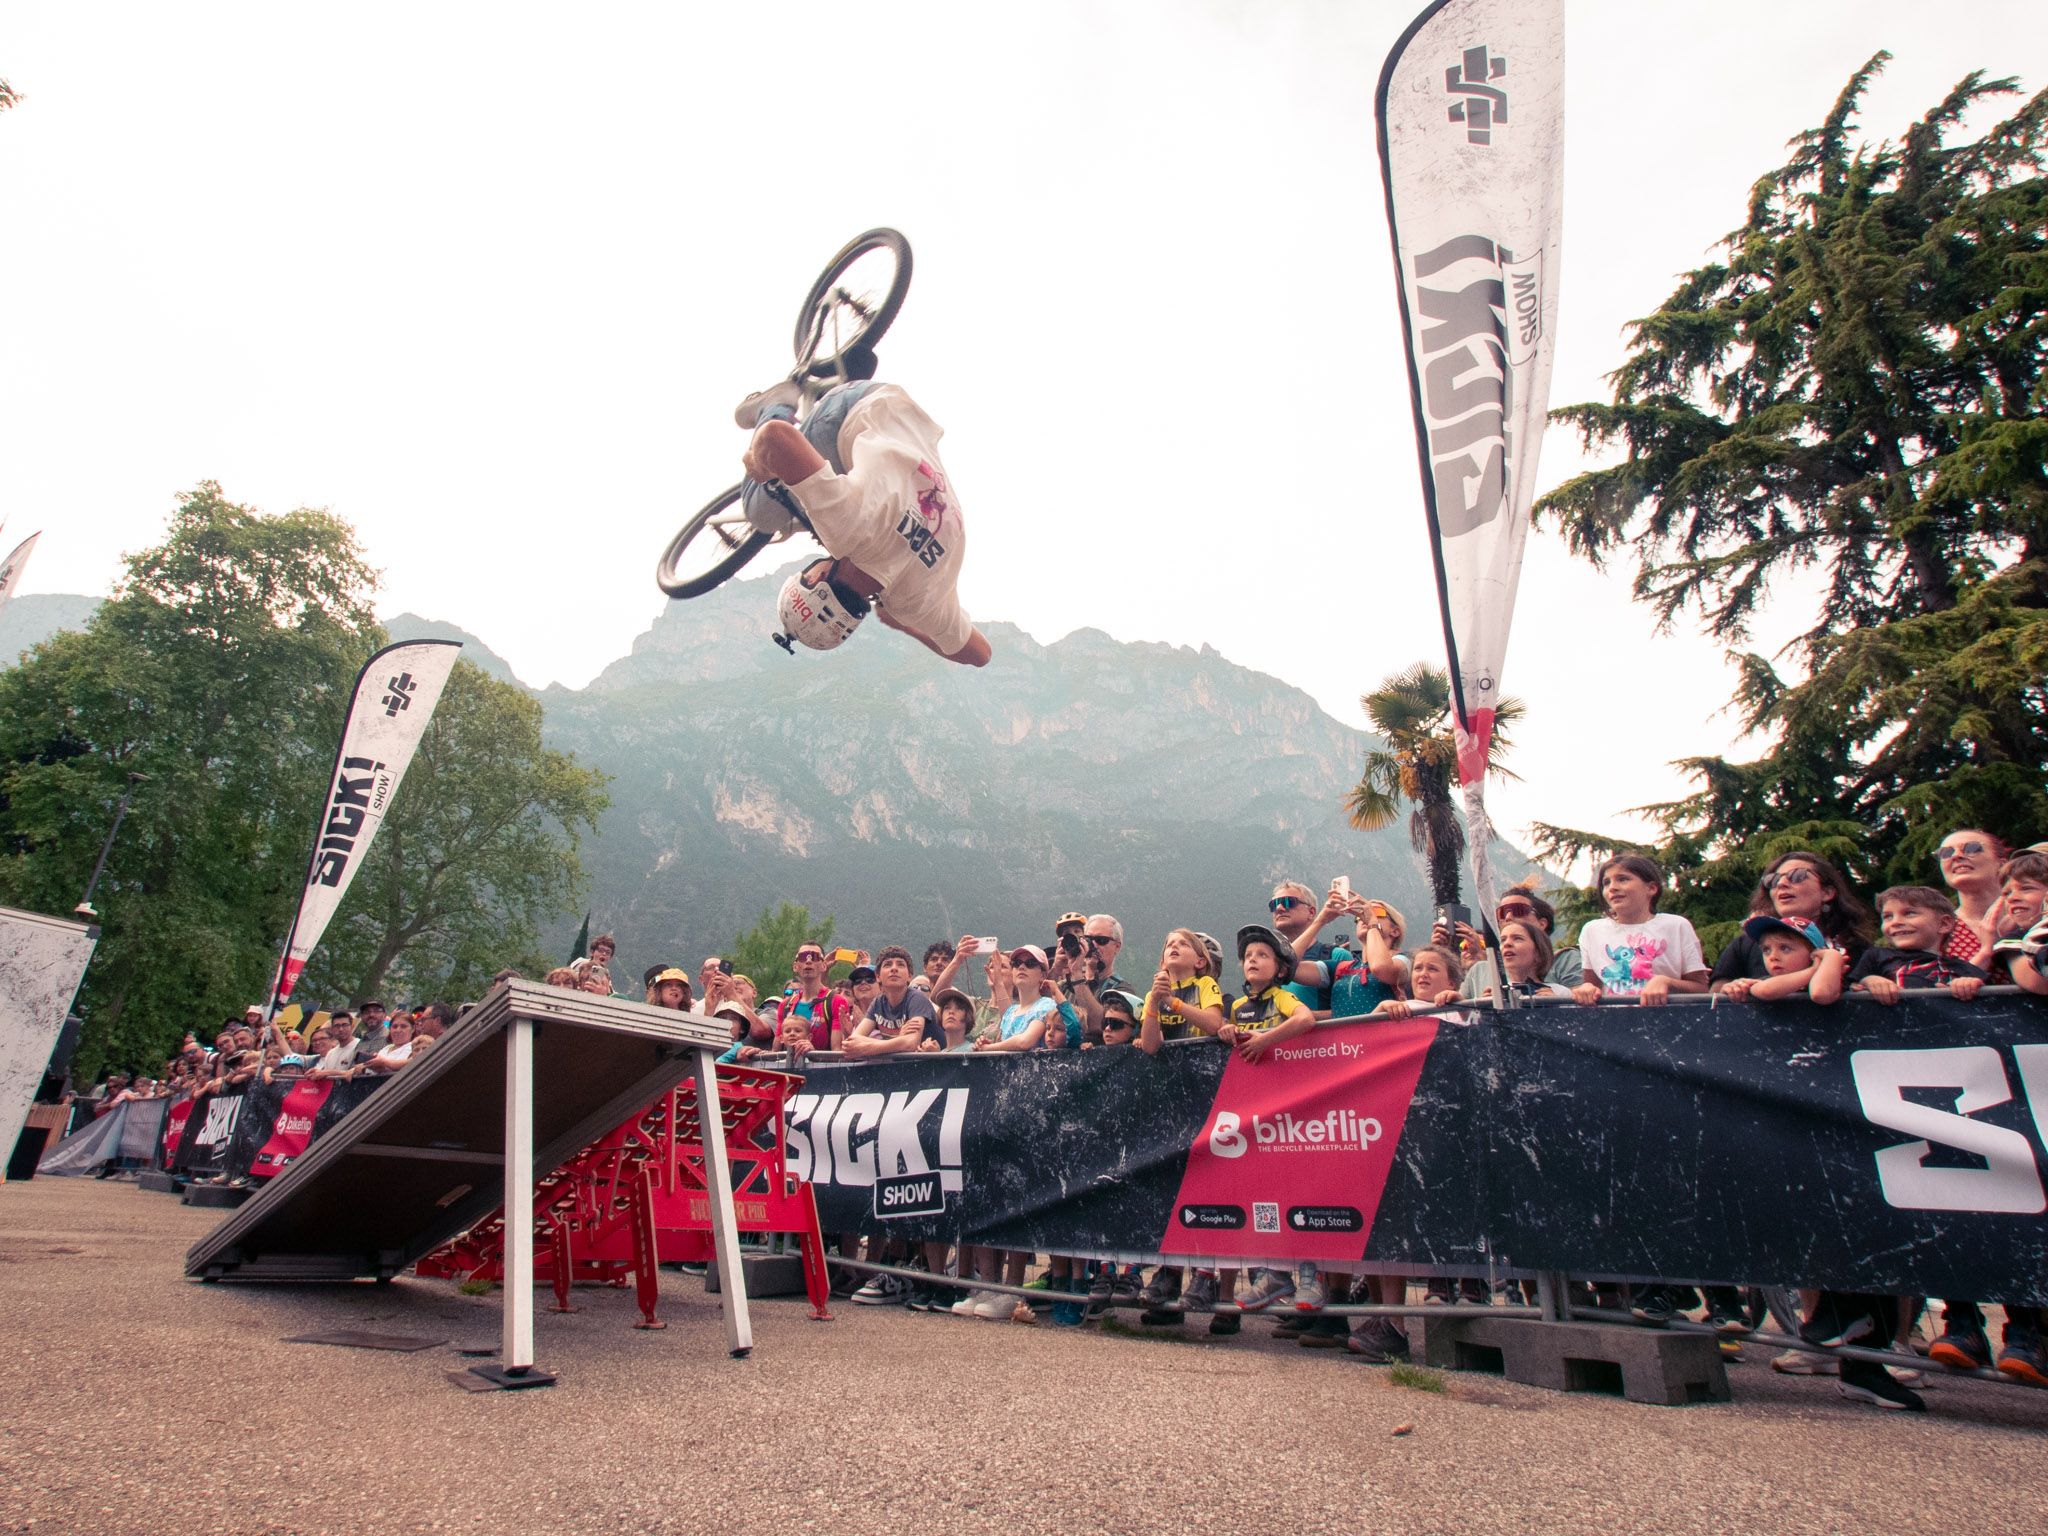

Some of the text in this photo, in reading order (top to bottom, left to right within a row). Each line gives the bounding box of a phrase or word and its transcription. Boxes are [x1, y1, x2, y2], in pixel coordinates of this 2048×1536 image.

[1511, 272, 1537, 346] SHOW
[1414, 234, 1514, 538] SICK!
[896, 510, 946, 569] SCK!
[373, 774, 391, 811] SHOW
[311, 756, 386, 888] SICK!
[1274, 1042, 1365, 1061] Powered by:
[764, 1088, 970, 1192] SICK!
[1252, 1109, 1383, 1151] bikeflip
[1273, 1145, 1303, 1153] BICYCLE
[1305, 1143, 1359, 1152] MARKETPLACE
[882, 1182, 933, 1206] SHOW
[1200, 1214, 1237, 1224] Google Play
[1308, 1216, 1352, 1227] App Store
